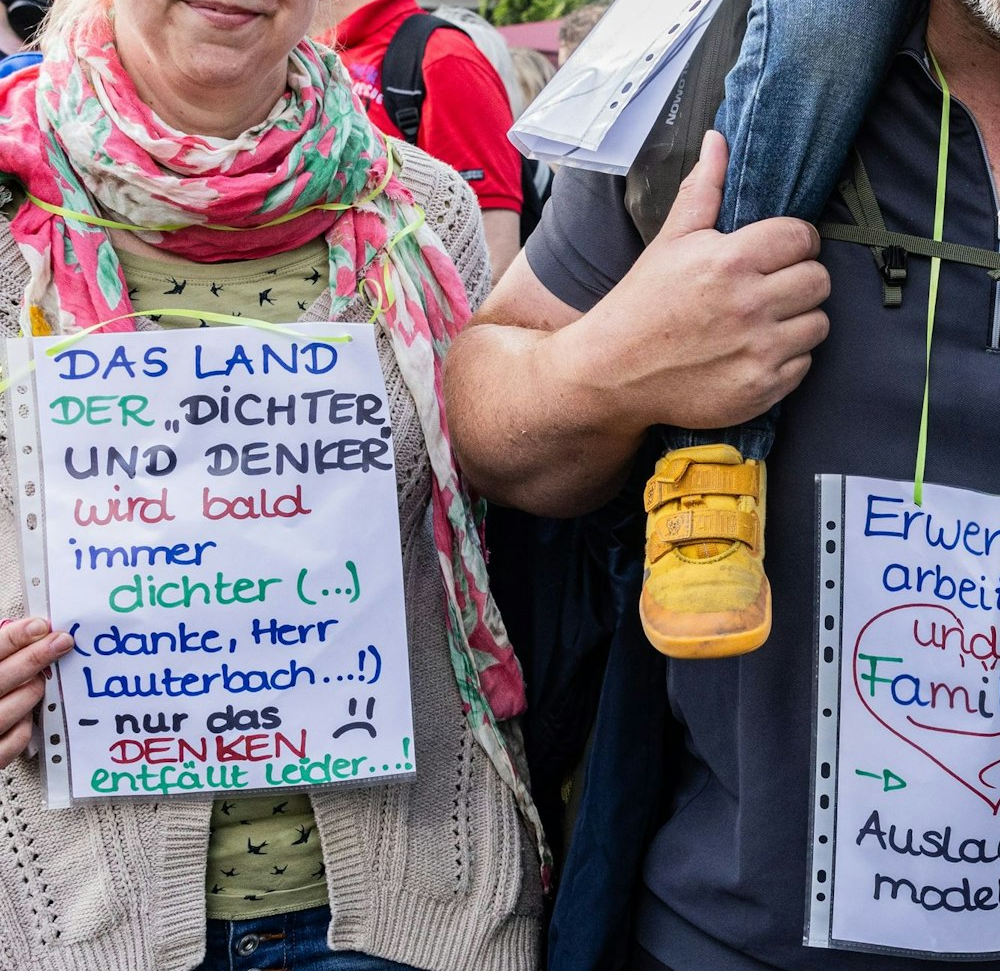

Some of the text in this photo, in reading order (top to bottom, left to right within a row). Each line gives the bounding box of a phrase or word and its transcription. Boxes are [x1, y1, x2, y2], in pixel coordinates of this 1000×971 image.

[54, 341, 339, 380] DAS LAND
[49, 394, 156, 428] DER
[64, 445, 178, 480] UND
[73, 484, 312, 527] wird bald
[68, 538, 218, 571] immer
[109, 569, 284, 614] dichter
[69, 617, 340, 656] (danke, Herr
[115, 710, 189, 735] nur
[206, 704, 282, 734] das
[110, 728, 307, 766] DENKEN
[90, 759, 249, 795] entfällt
